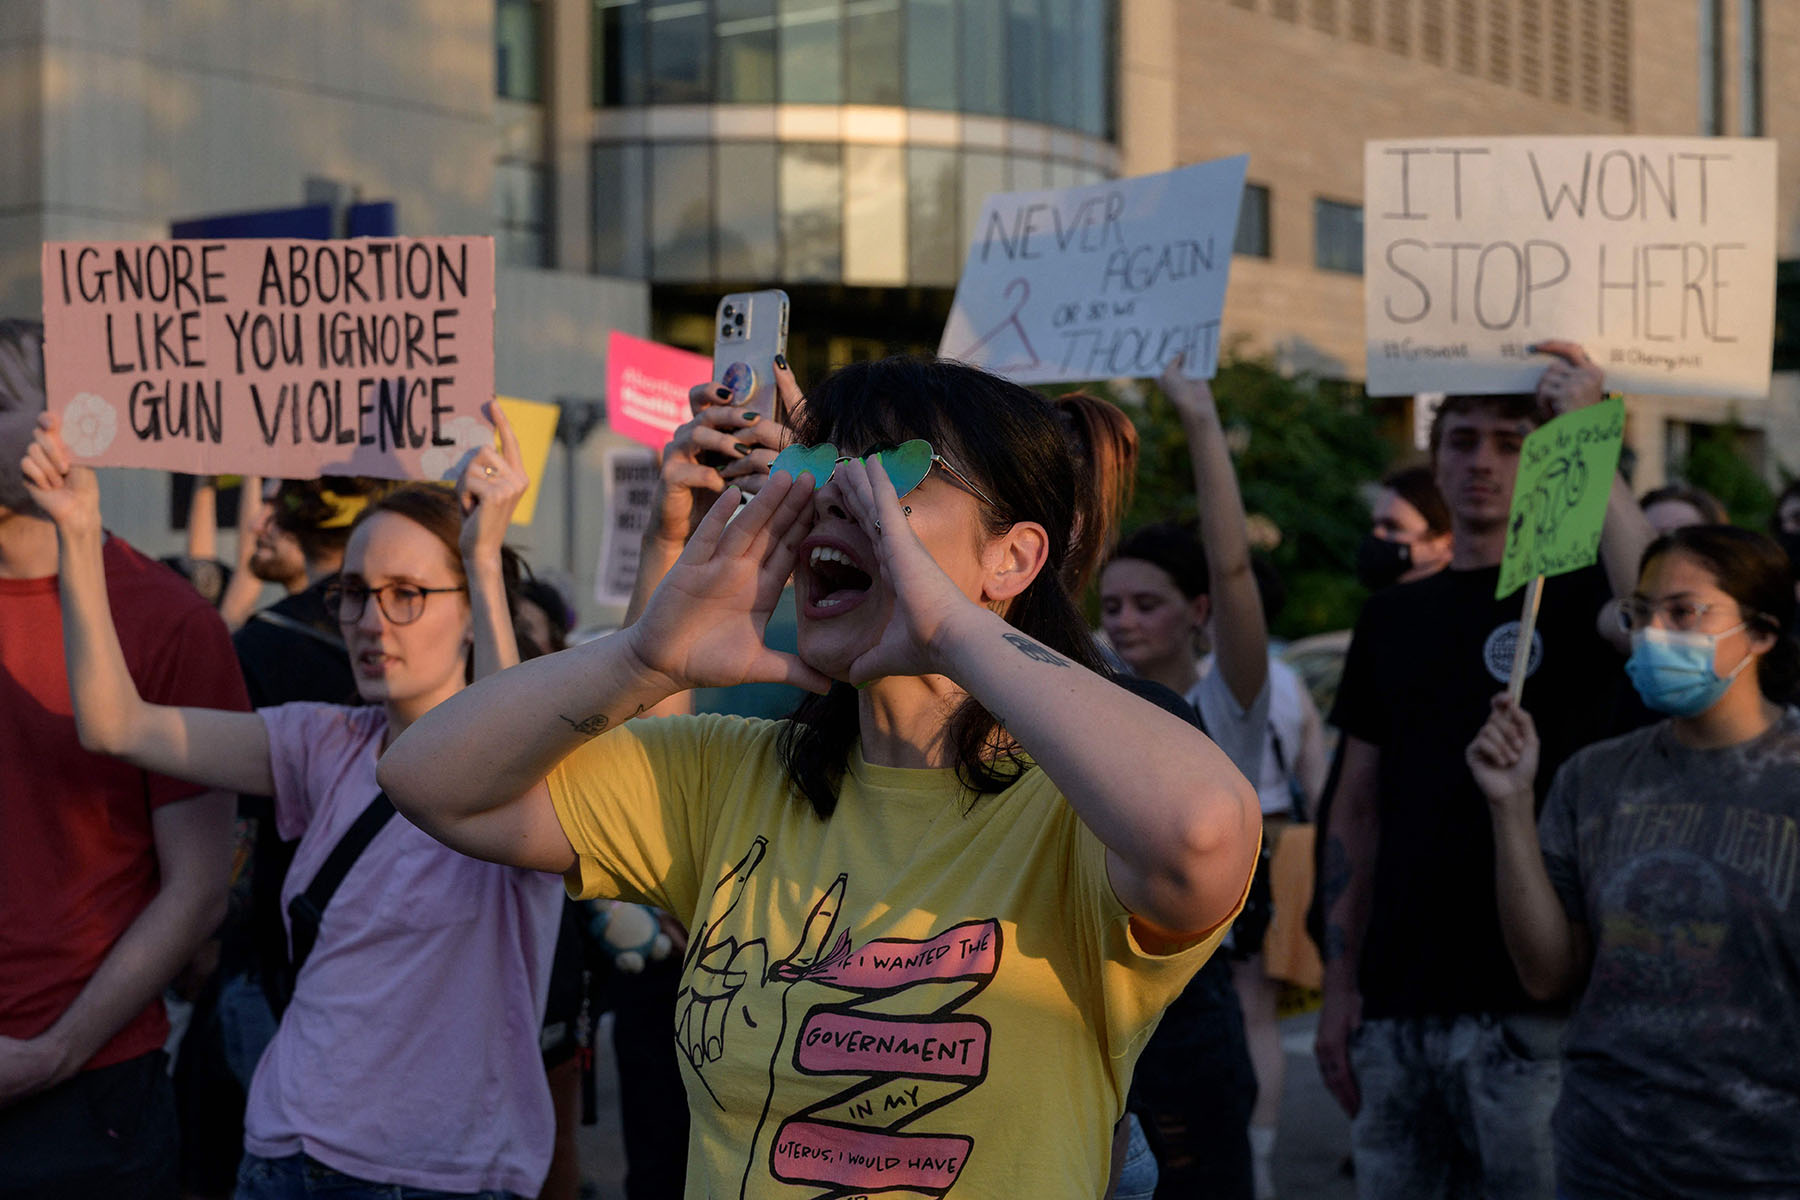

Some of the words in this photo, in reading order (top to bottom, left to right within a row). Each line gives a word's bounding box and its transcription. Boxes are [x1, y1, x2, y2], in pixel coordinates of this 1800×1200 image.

[1382, 147, 1490, 221] IT
[1528, 149, 1732, 226] WONT
[981, 190, 1125, 264] NEVER
[60, 245, 228, 308] IGNORE
[258, 243, 468, 305] ABORTION
[1103, 236, 1215, 292] AGAIN
[1384, 238, 1571, 331] STOP
[1599, 242, 1746, 342] HERE
[106, 312, 206, 373] LIKE
[225, 311, 302, 373] YOU
[318, 309, 459, 369] IGNORE
[1059, 319, 1220, 375] THOUGHT
[129, 380, 222, 443] GUN
[250, 377, 456, 452] VIOLENCE
[859, 956, 865, 967] I
[874, 945, 951, 971] WANTED
[959, 933, 990, 959] THE
[806, 1027, 976, 1065] GOVERNMENT
[849, 1100, 873, 1120] IN
[883, 1085, 919, 1111] MY
[778, 1141, 834, 1164] UTERUS,
[838, 1151, 844, 1162] I
[848, 1152, 900, 1173] WOULD
[909, 1157, 957, 1175] HAVE
